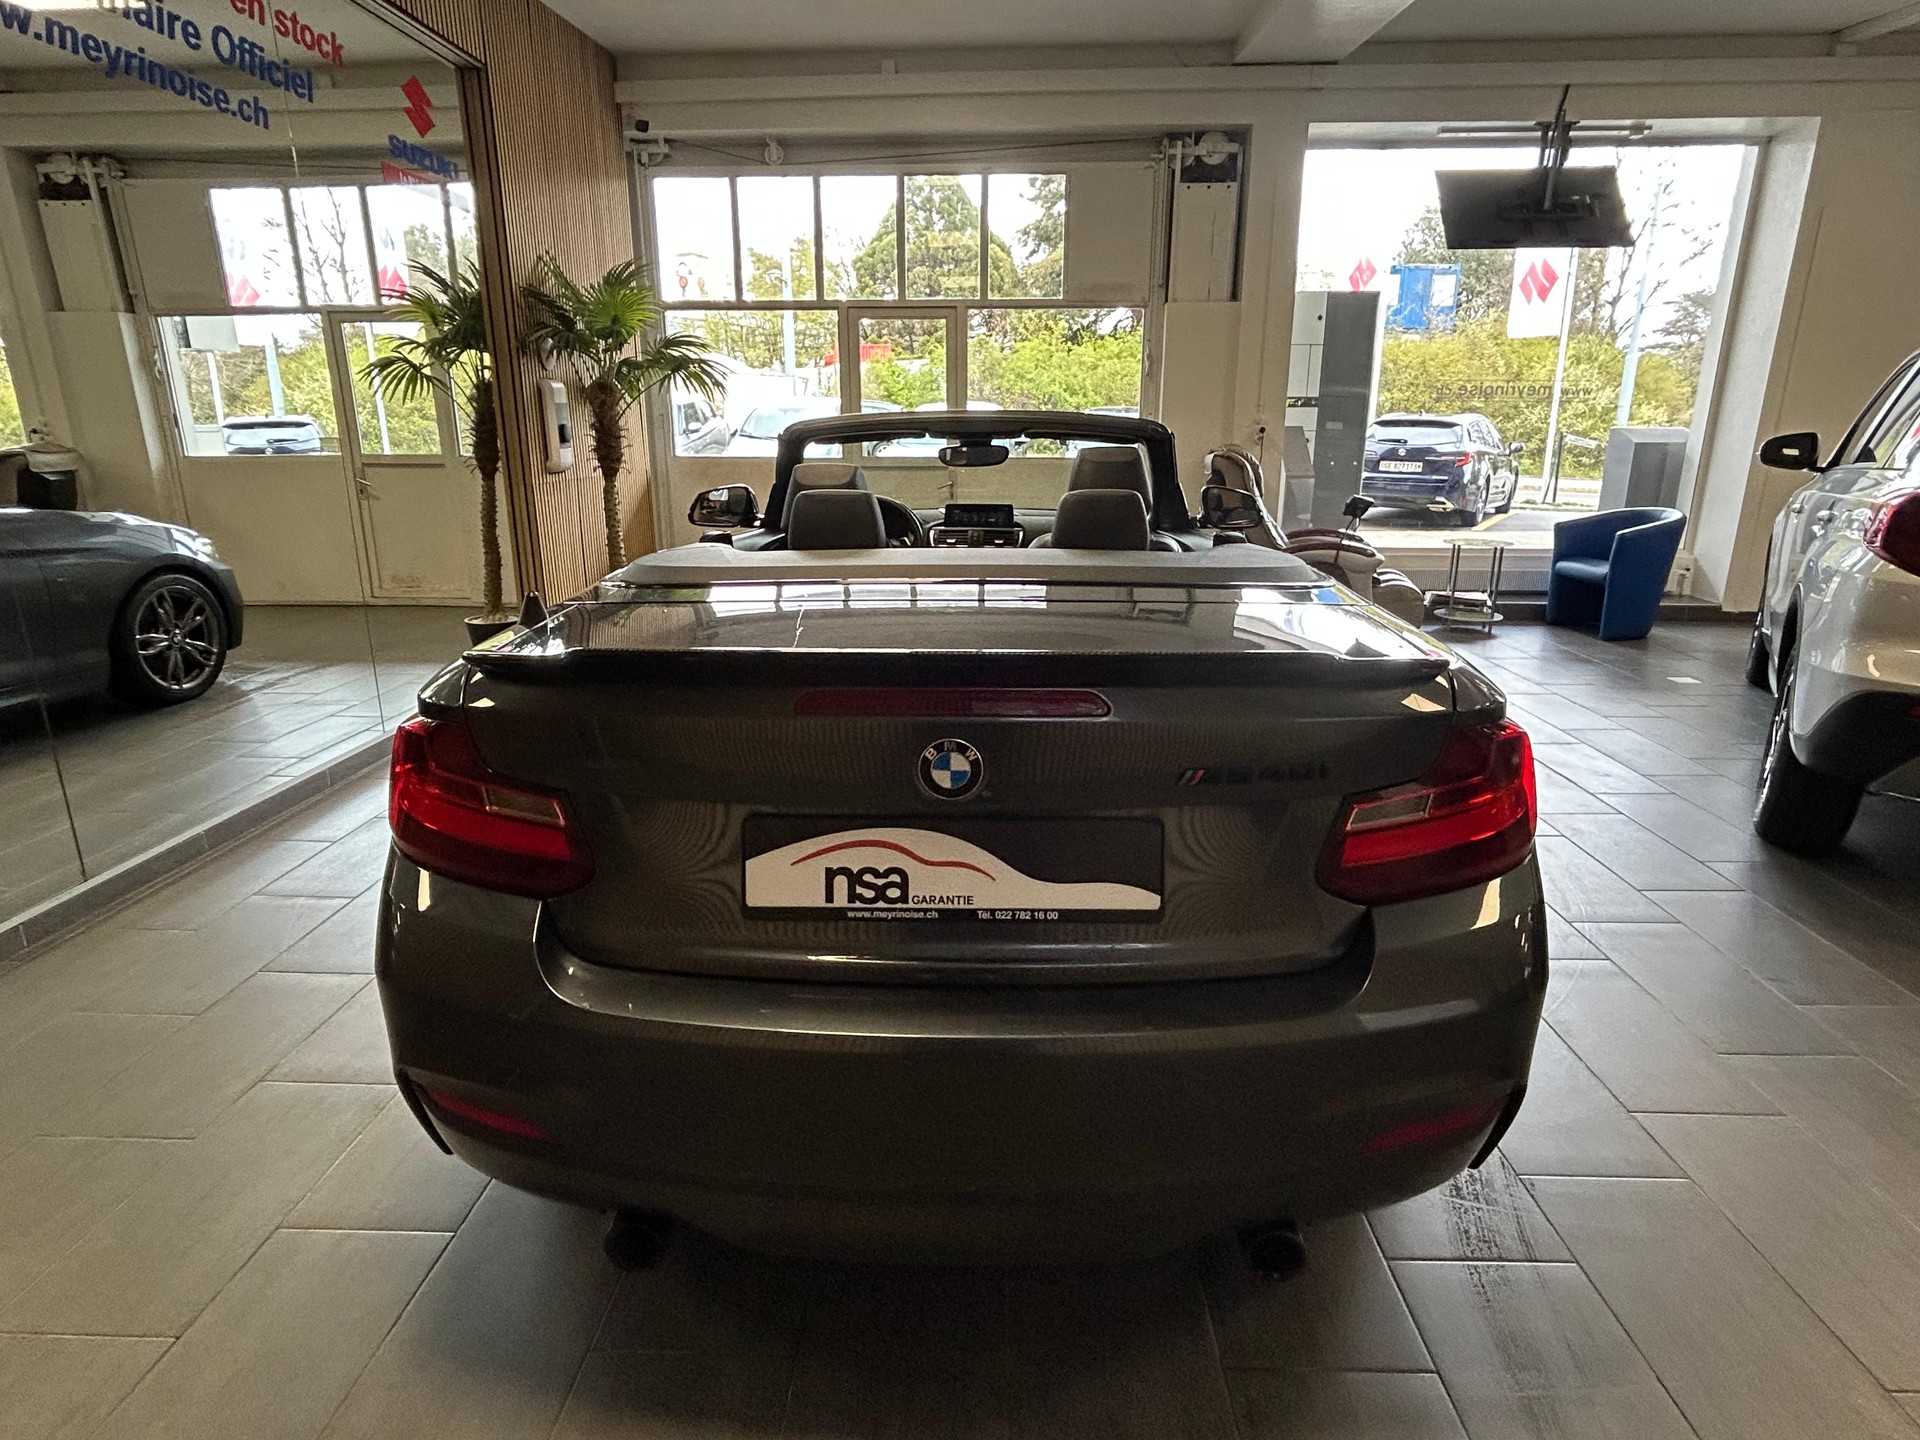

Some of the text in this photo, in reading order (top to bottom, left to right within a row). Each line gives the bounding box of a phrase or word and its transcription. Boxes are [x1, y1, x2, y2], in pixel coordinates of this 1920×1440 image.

[274, 9, 346, 68] stock
[211, 25, 313, 103] Officiel
[925, 741, 978, 761] BMW
[825, 867, 974, 905] nsa GARANTIE
[847, 909, 938, 920] www.meyrinoise.ch
[995, 911, 1012, 920] 022
[1014, 911, 1032, 920] 782
[1034, 911, 1044, 920] 16
[1047, 911, 1058, 920] 00
